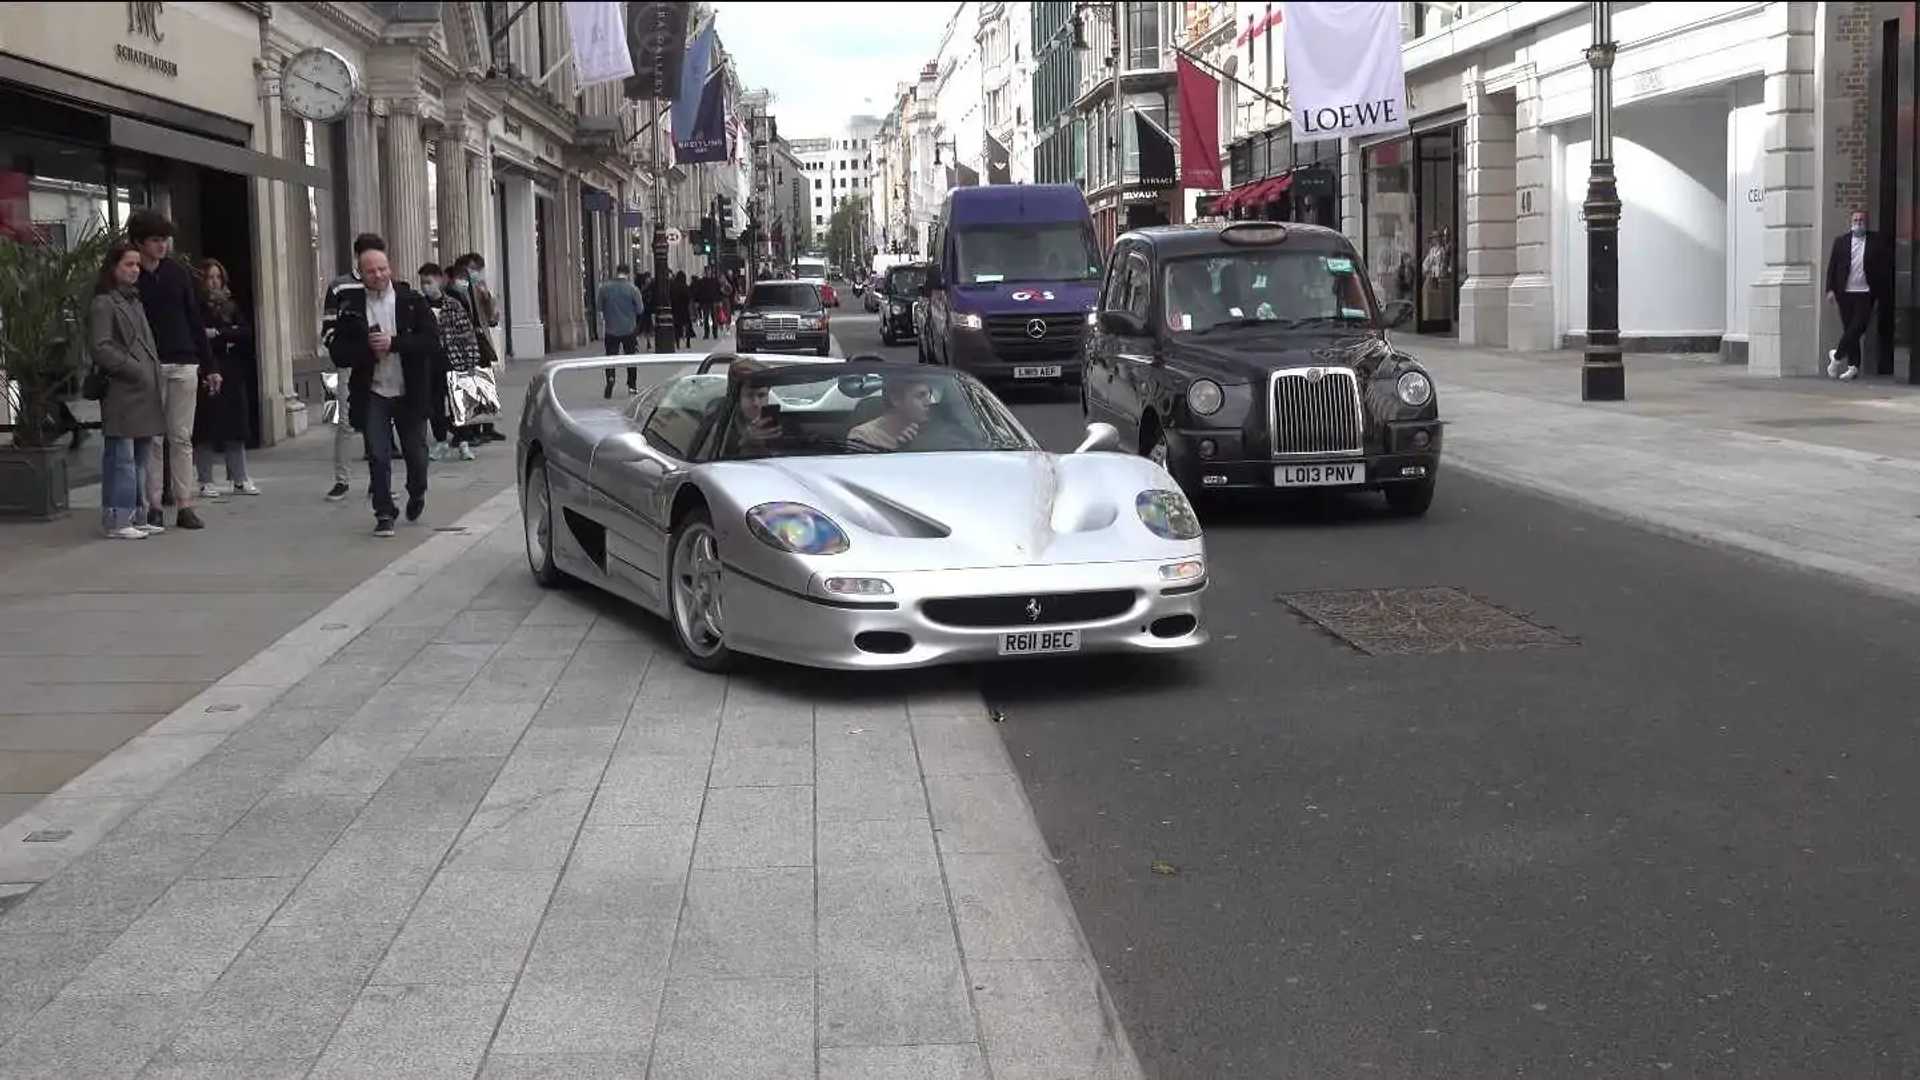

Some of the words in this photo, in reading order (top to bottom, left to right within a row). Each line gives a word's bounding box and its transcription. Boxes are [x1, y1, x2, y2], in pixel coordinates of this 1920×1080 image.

[1303, 98, 1398, 133] LOEWE
[1521, 190, 1533, 214] 40
[1011, 287, 1056, 304] G4S
[1285, 467, 1321, 483] LO13
[1325, 465, 1355, 481] PNV
[1006, 633, 1038, 651] R611
[1041, 632, 1074, 649] BEC
